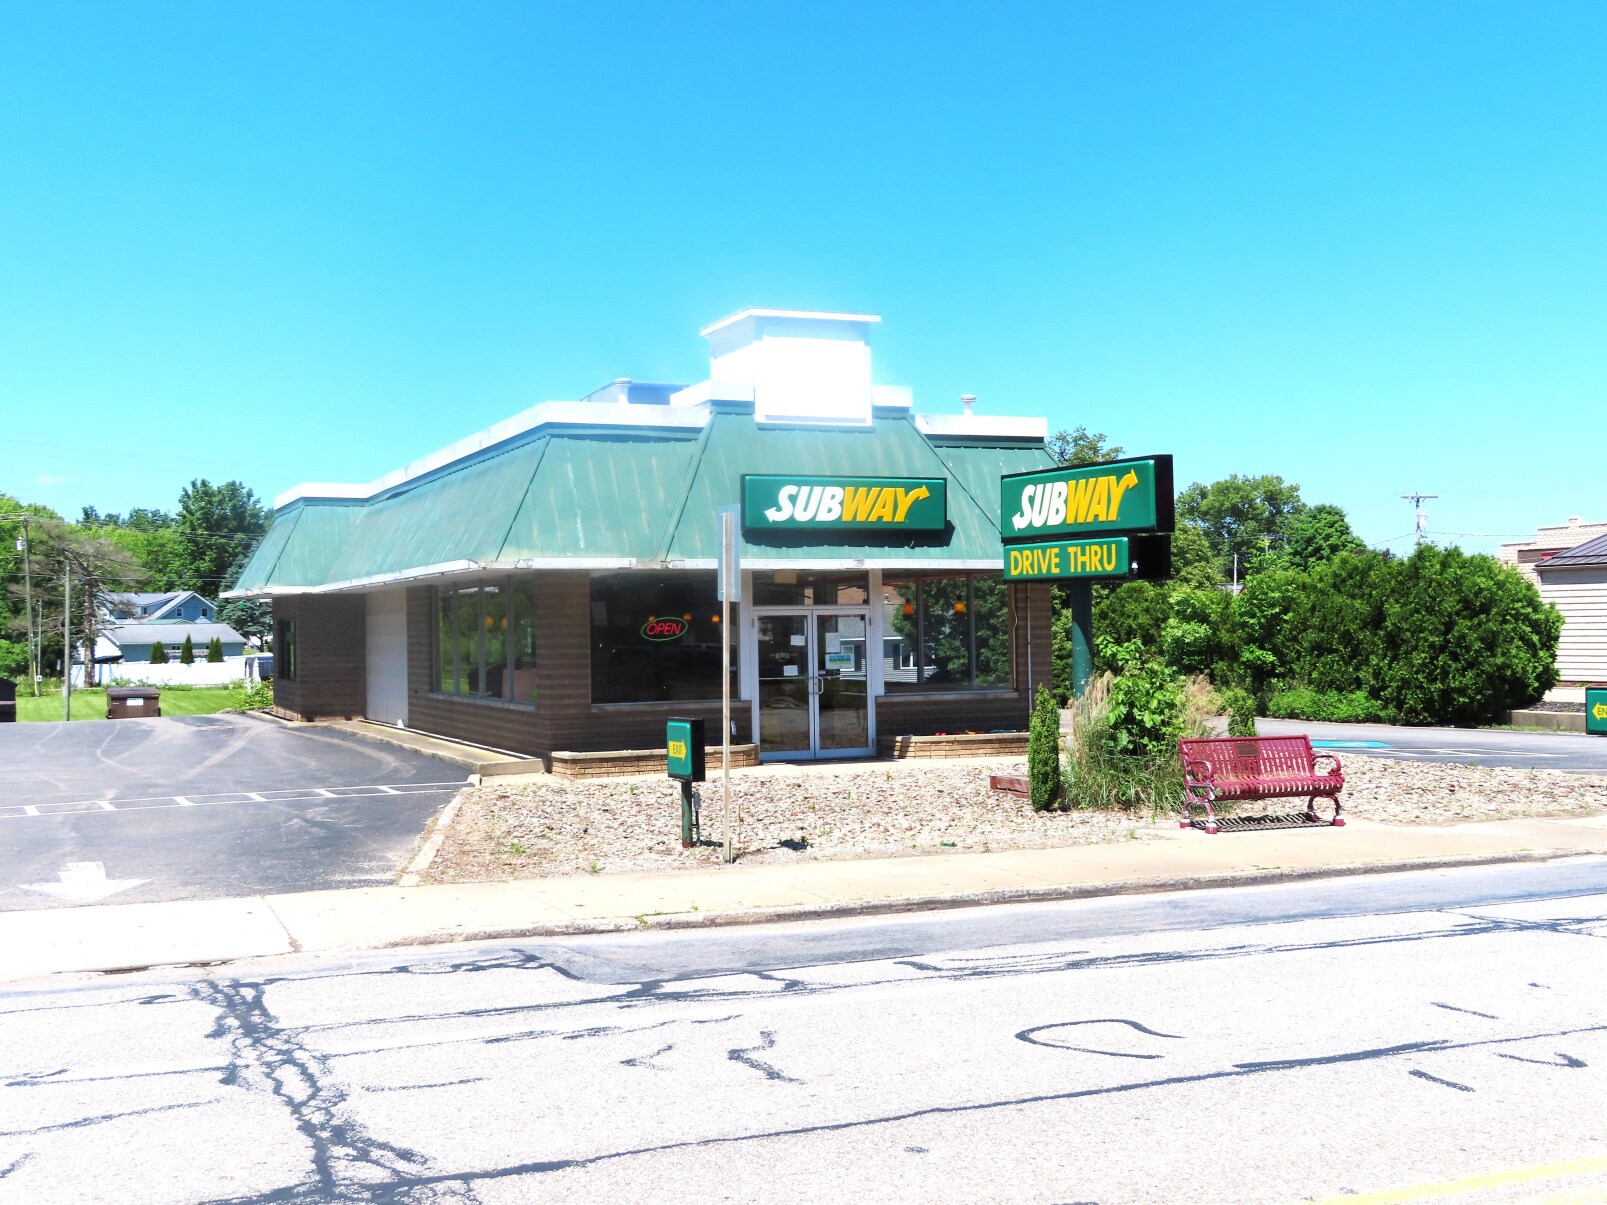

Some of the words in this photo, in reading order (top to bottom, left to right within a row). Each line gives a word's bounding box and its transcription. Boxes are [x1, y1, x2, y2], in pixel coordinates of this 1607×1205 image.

[764, 485, 930, 522] SUBWAY
[1012, 469, 1138, 531] SUBWAY
[1010, 548, 1060, 576] DRIVE
[1067, 543, 1116, 573] THRU
[646, 622, 682, 635] OPEN
[672, 743, 683, 756] EXIT
